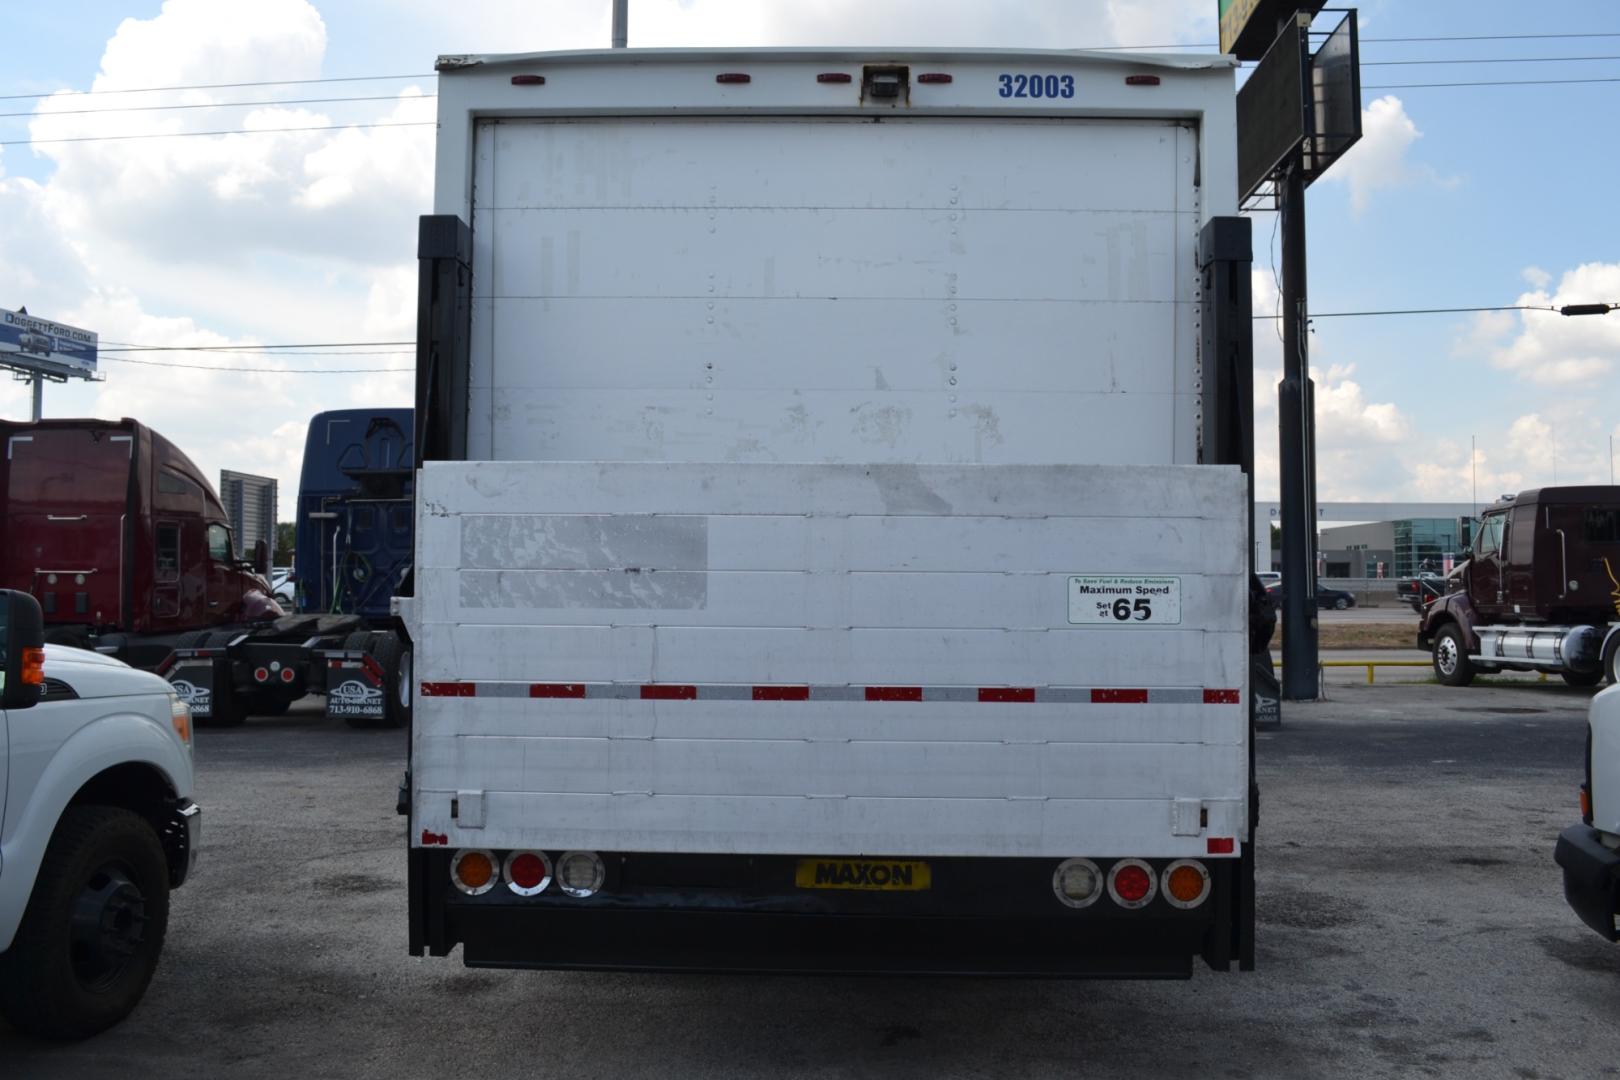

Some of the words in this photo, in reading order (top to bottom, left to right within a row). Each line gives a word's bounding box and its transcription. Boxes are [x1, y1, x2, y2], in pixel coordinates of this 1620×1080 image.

[999, 74, 1074, 98] 32003
[1080, 586, 1132, 594] Maximum
[1135, 586, 1169, 596] Speed
[1113, 598, 1151, 620] 65
[343, 685, 362, 694] USA
[329, 705, 382, 713] 713-910-6868
[816, 863, 912, 885] MAXON
